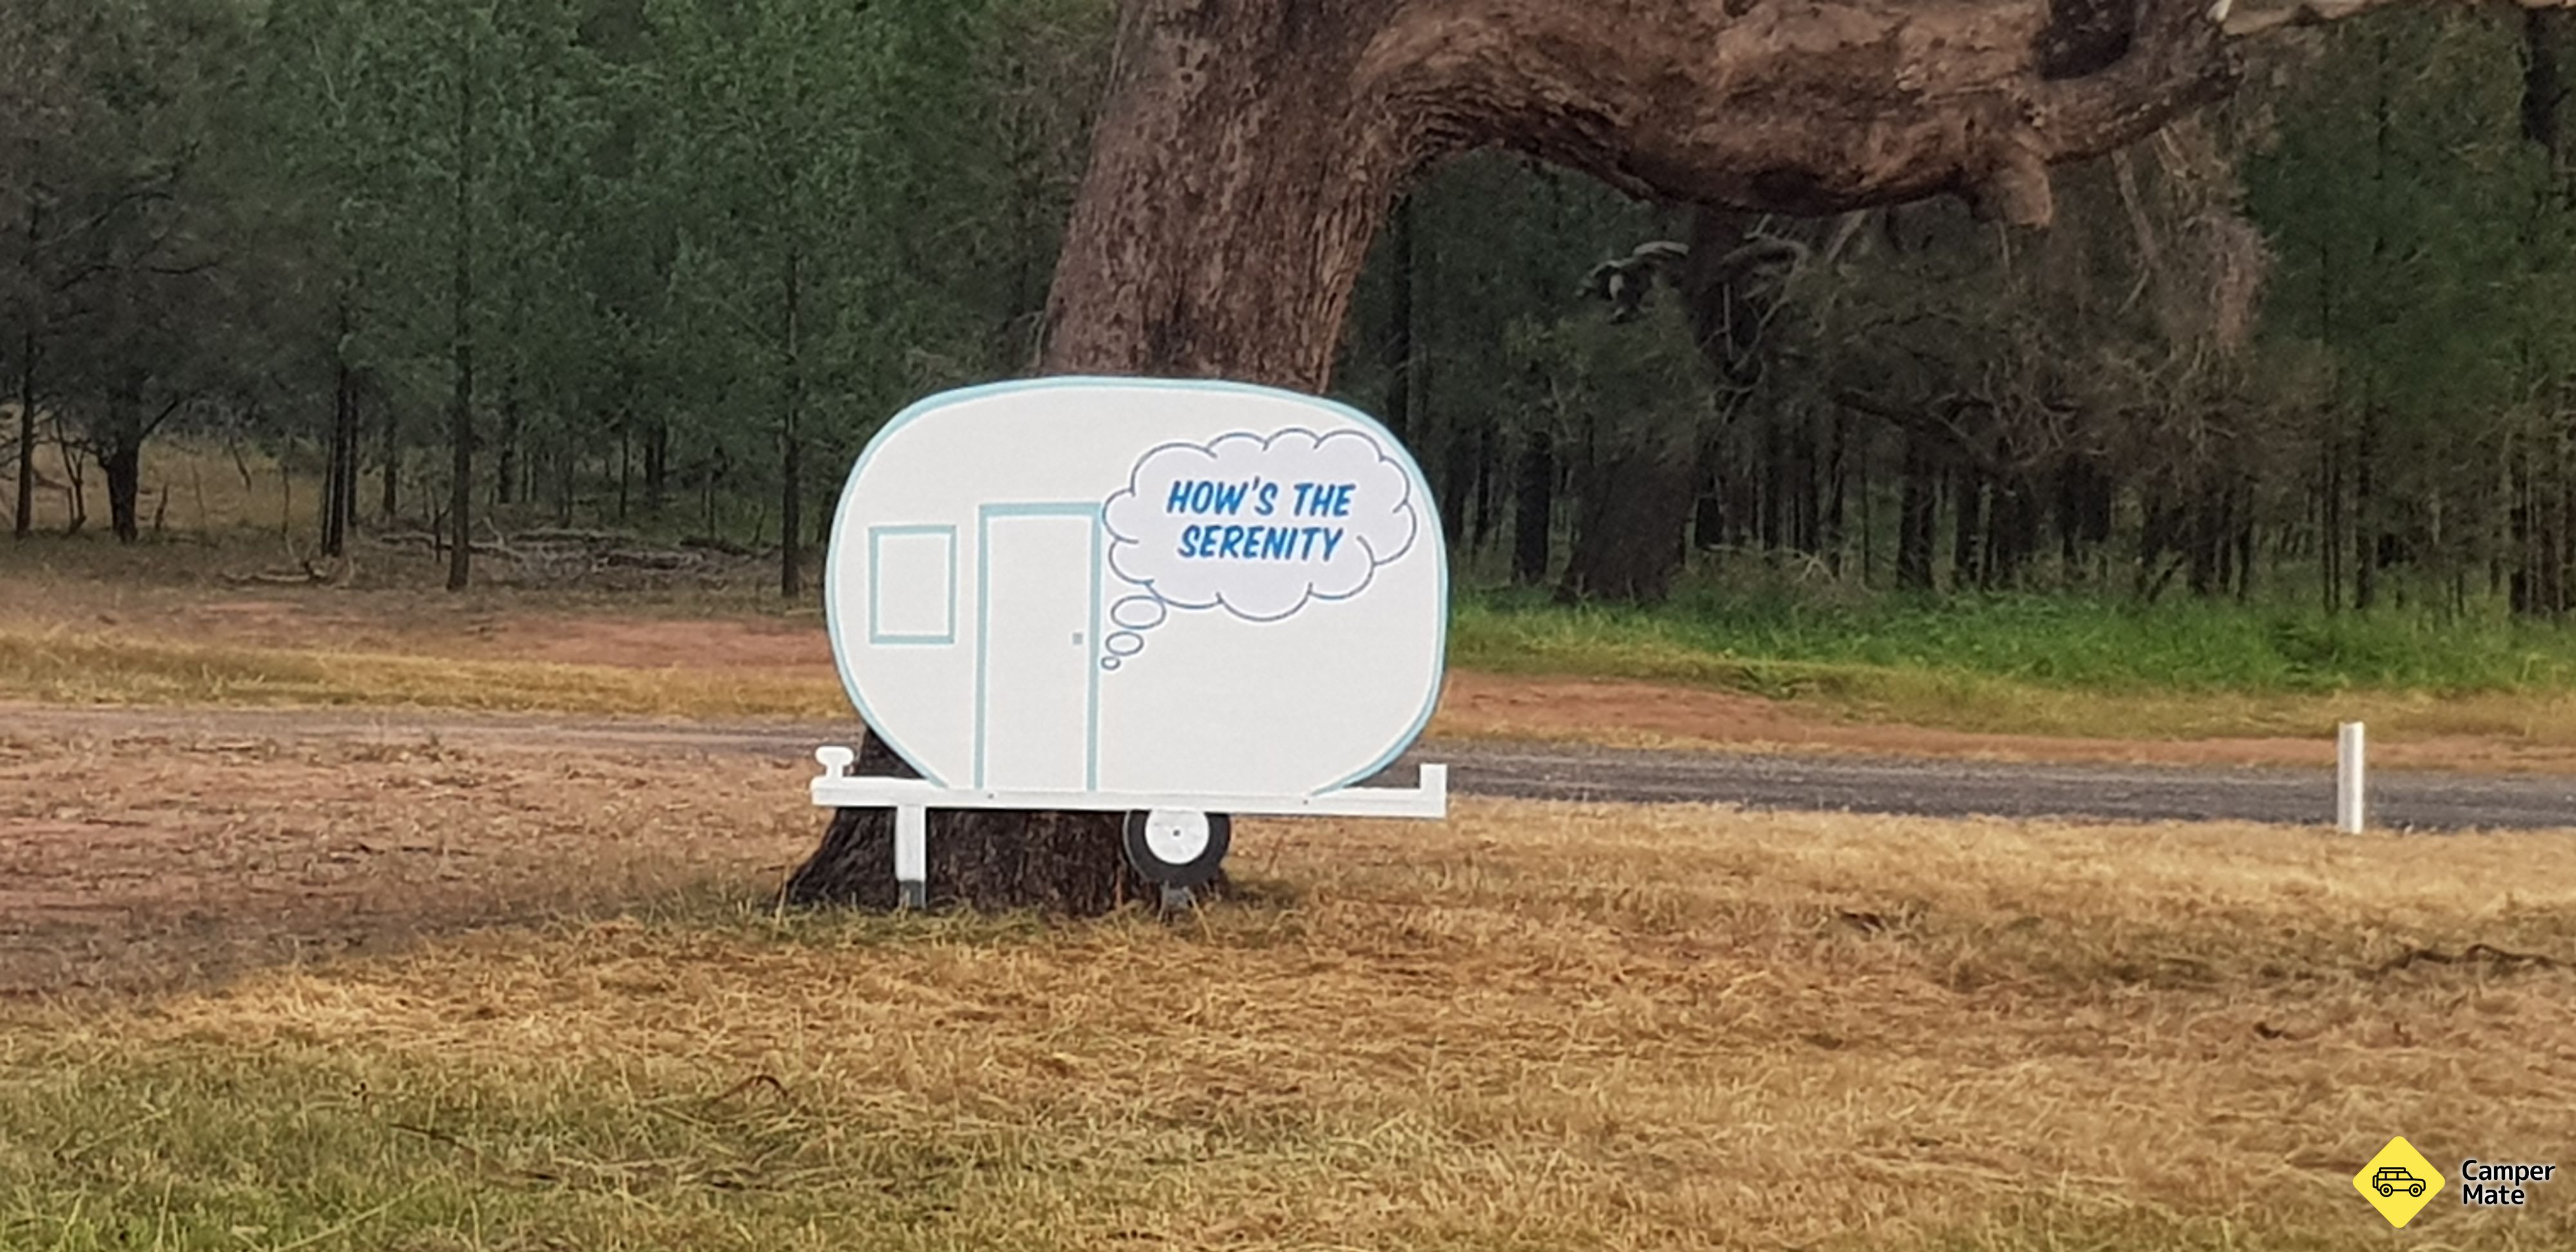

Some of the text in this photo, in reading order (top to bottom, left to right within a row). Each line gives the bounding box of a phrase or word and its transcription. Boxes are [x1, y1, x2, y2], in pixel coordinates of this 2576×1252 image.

[1166, 477, 1356, 517] HOW'S THE
[1177, 524, 1343, 562] SERENITY
